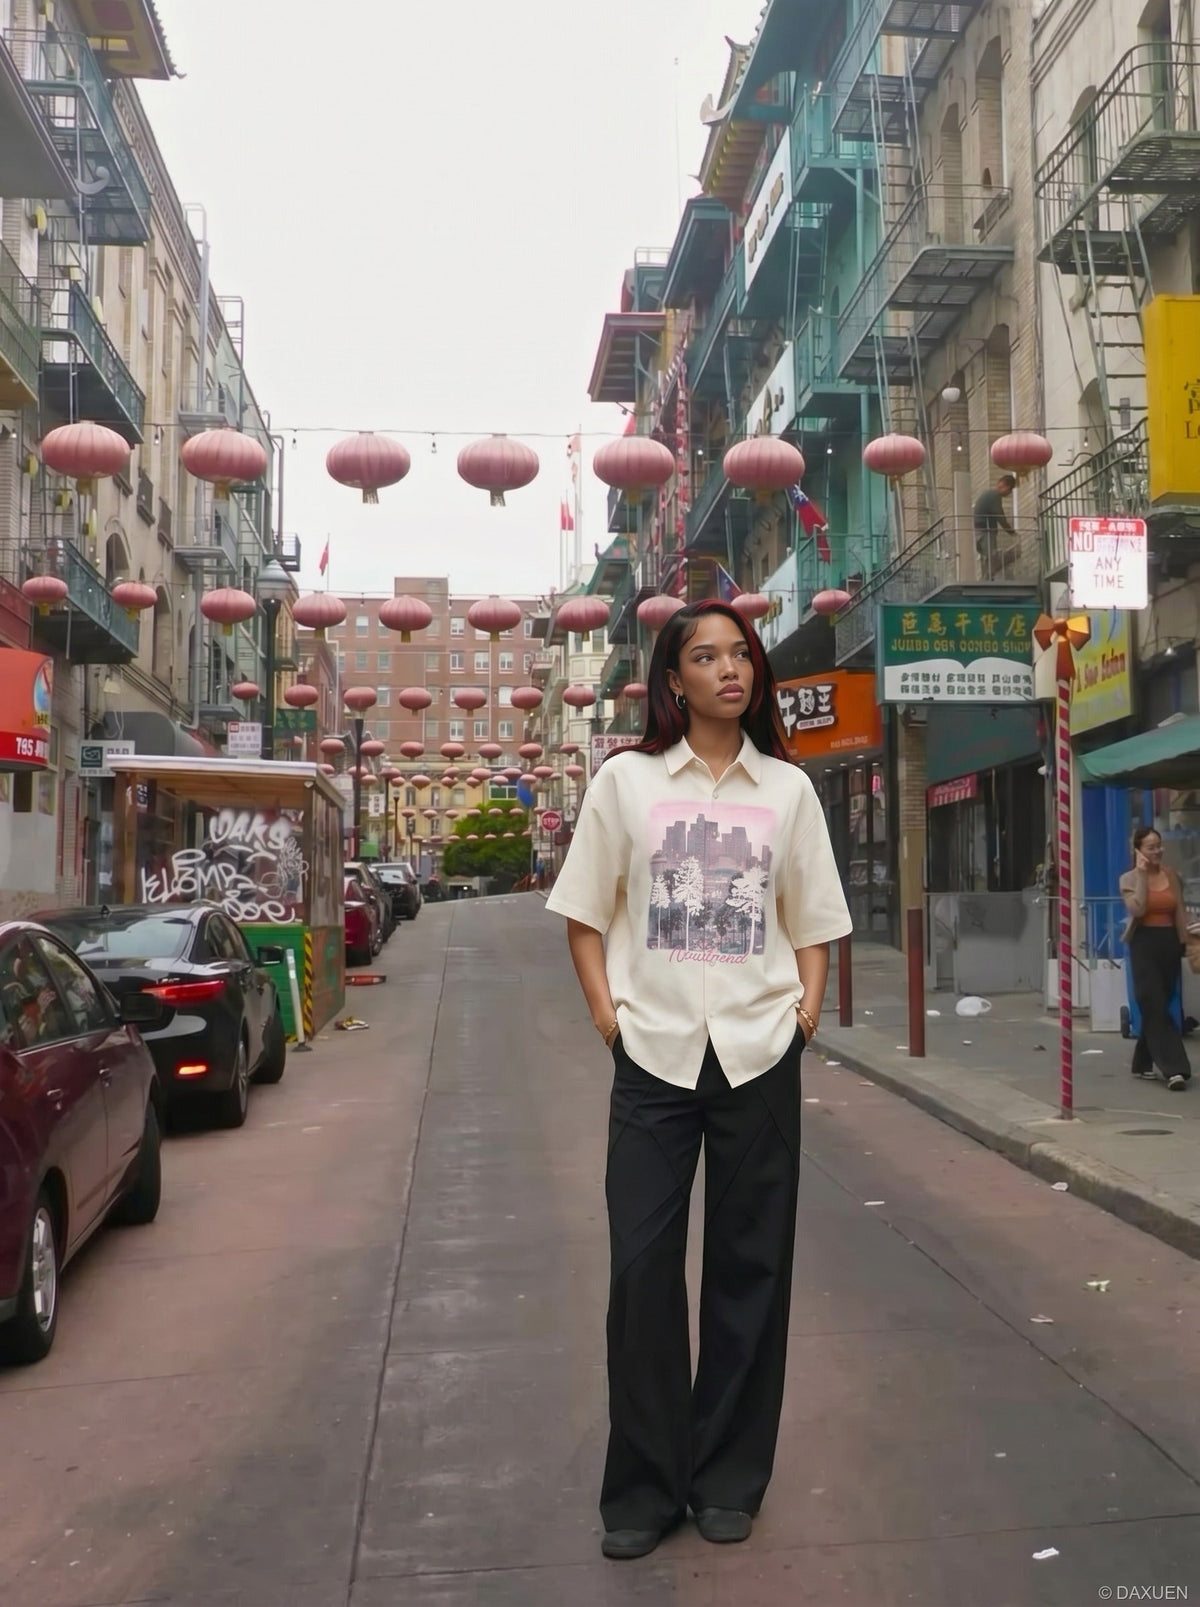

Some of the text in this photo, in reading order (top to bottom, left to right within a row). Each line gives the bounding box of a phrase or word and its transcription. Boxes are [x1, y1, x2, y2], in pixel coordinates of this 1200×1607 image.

[1073, 532, 1094, 552] NO
[1096, 557, 1122, 571] ANY
[1094, 574, 1124, 589] TIME
